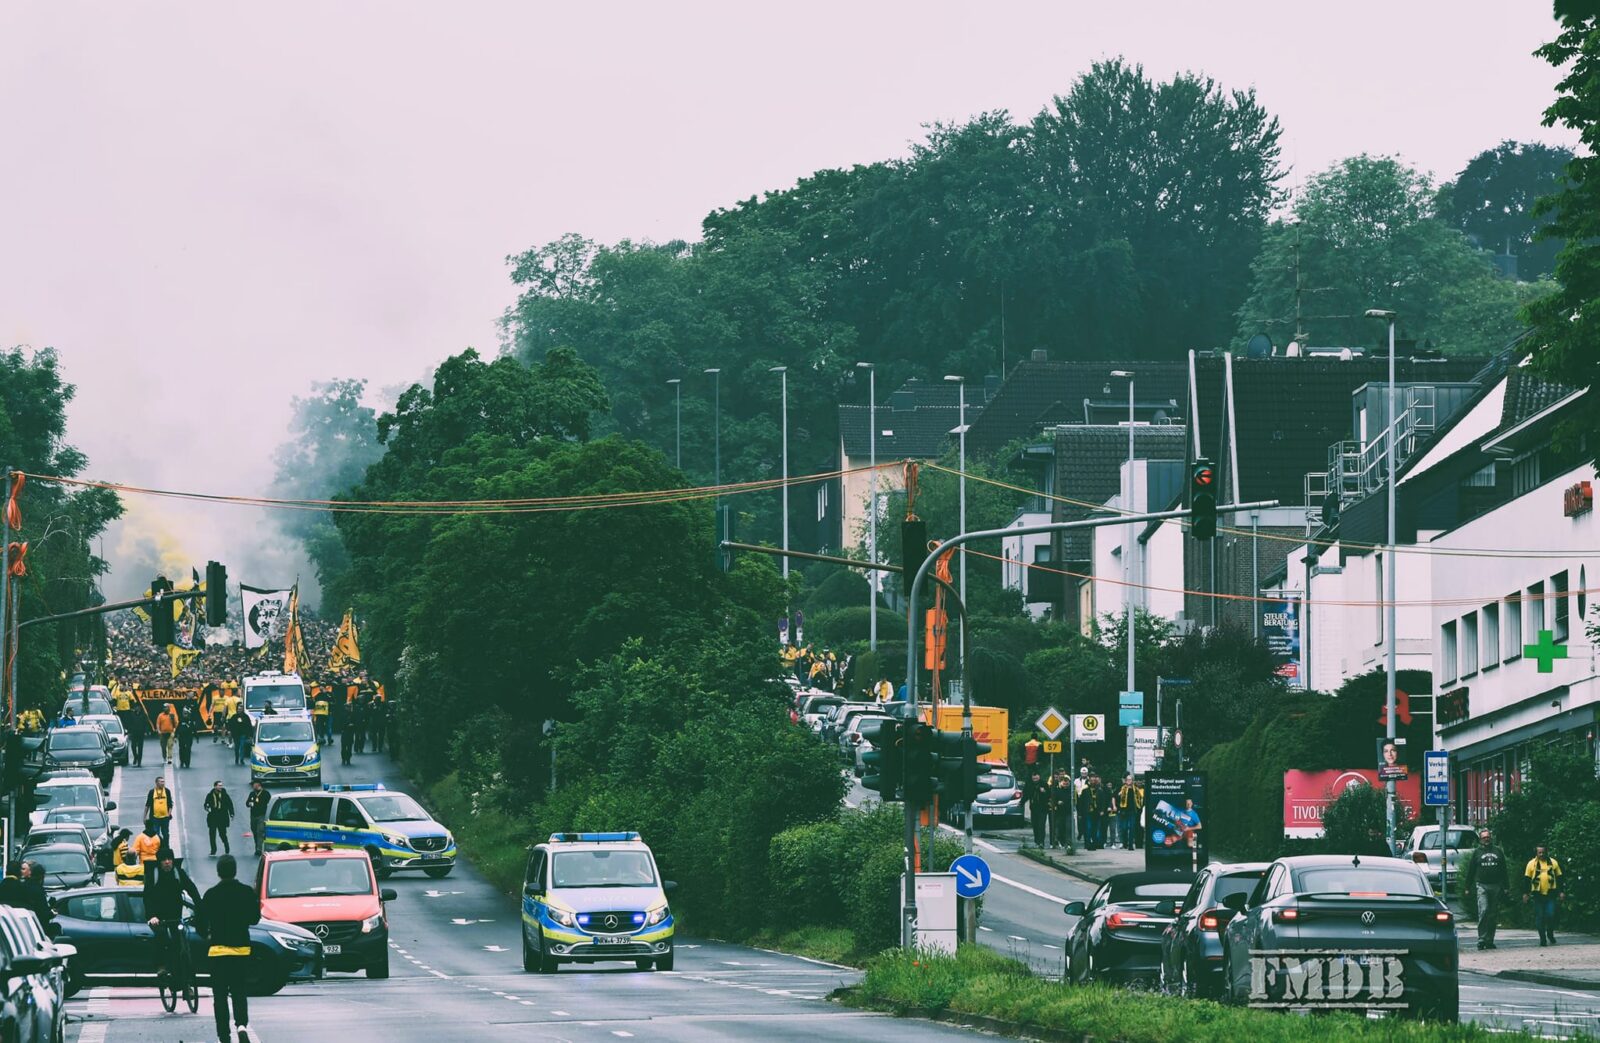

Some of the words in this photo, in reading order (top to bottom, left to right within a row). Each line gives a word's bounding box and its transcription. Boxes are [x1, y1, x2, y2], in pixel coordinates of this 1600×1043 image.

[1264, 612, 1289, 620] STEUER
[1264, 619, 1298, 627] BERATUNG
[141, 690, 198, 699] ALEMANNA
[1047, 743, 1058, 751] 57
[326, 945, 339, 953] 932
